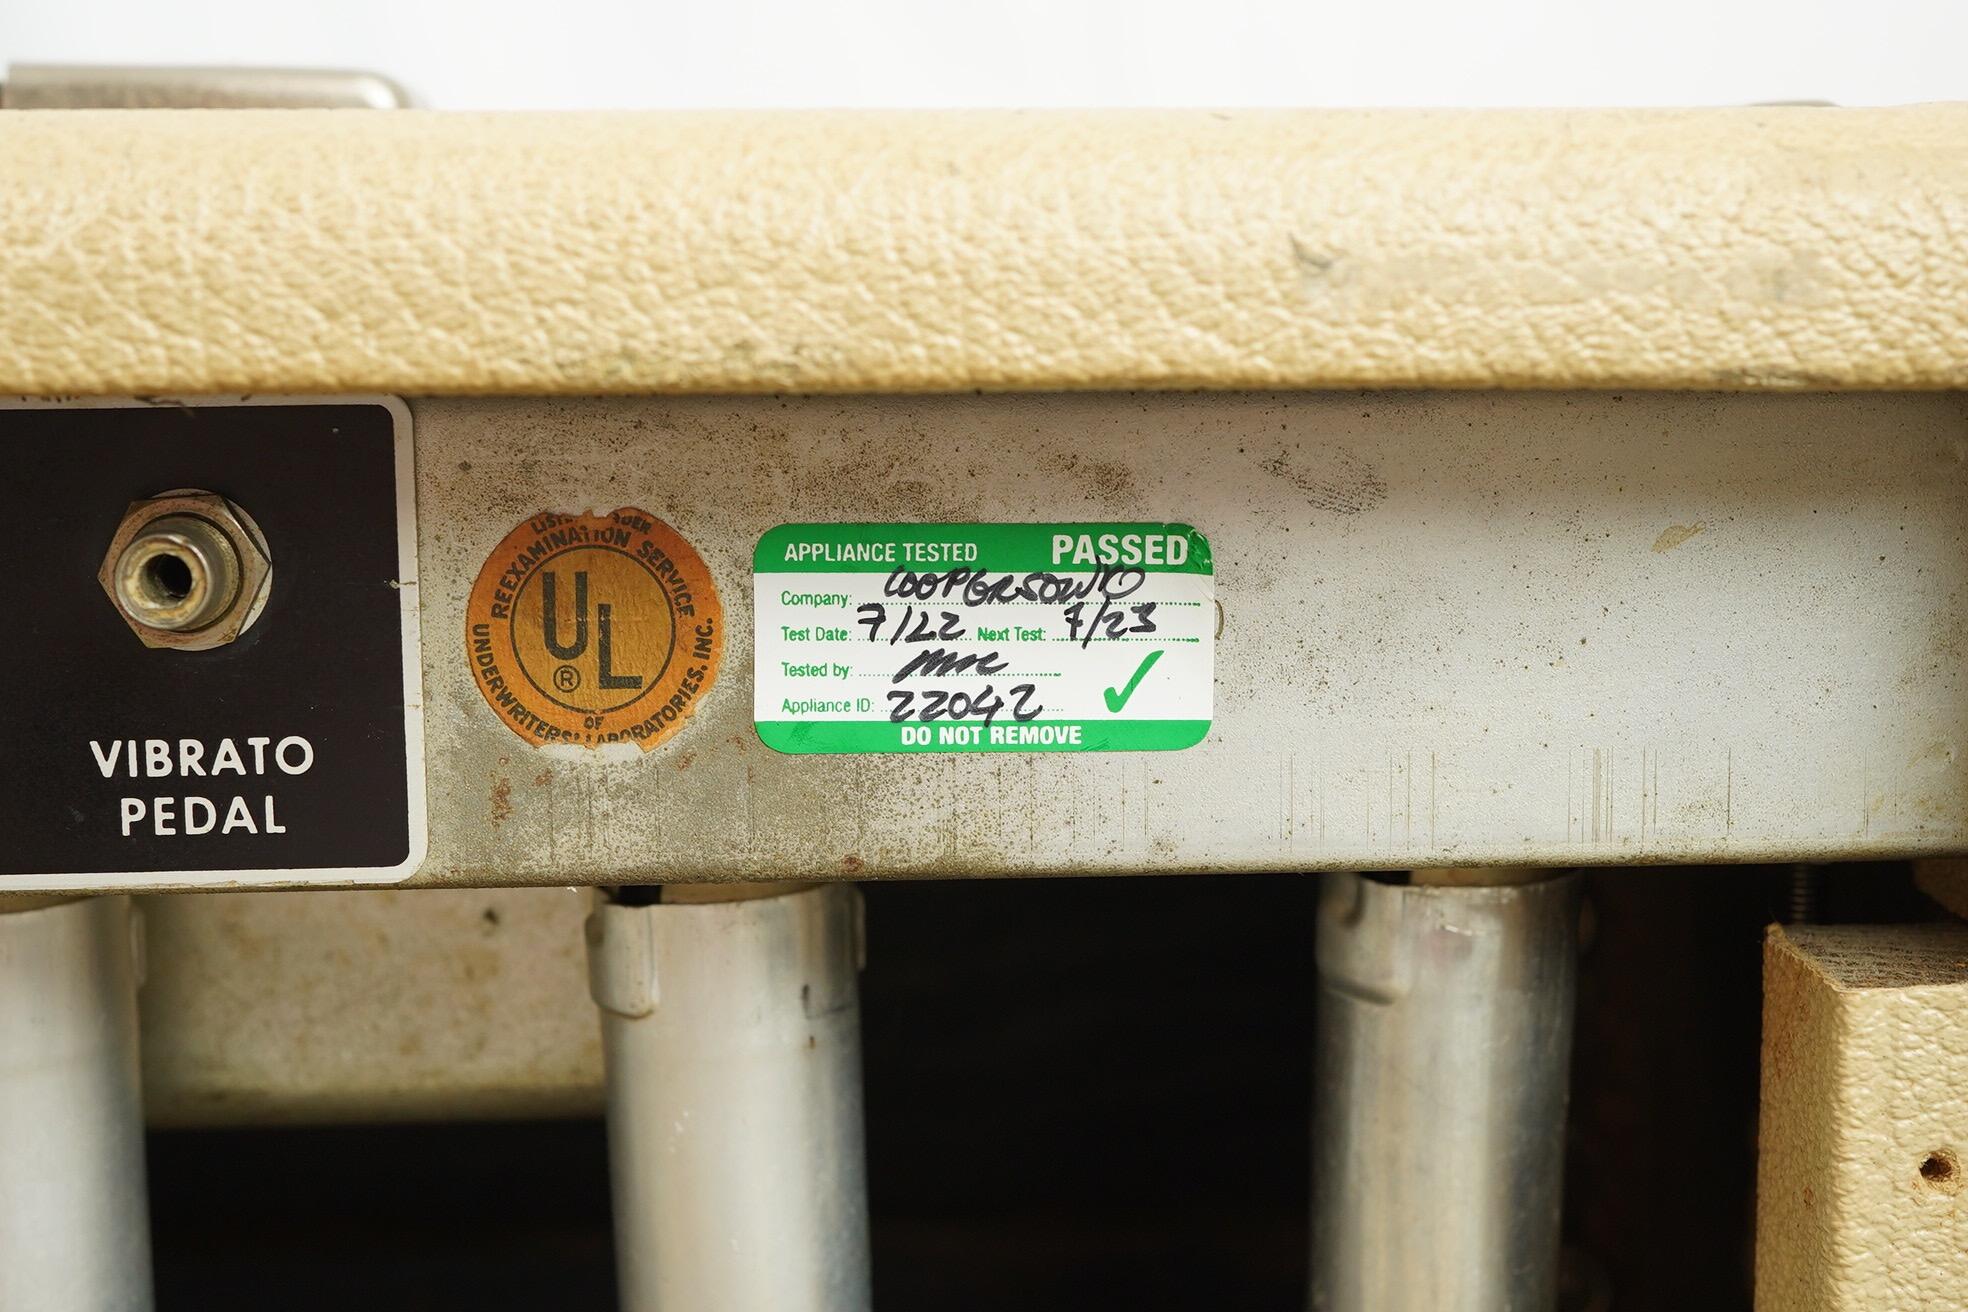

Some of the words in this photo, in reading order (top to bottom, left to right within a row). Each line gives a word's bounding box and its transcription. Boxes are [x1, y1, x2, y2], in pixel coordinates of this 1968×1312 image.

[784, 543, 896, 562] APPLIANCE
[902, 543, 978, 562] TESTED
[1052, 534, 1188, 565] PASSED
[491, 525, 632, 619] REEXAMINATION
[636, 540, 695, 618] SERVICE
[781, 590, 852, 608] Company:
[542, 571, 643, 690] UL
[781, 626, 810, 641] Test
[815, 627, 852, 641] Date:
[977, 627, 1010, 641] Next
[1013, 626, 1047, 642] Test:
[781, 662, 828, 677] Tested
[832, 661, 853, 680] by:
[781, 698, 851, 714] Appliance
[856, 698, 875, 712] ID:
[886, 684, 1043, 728] 22042
[583, 716, 604, 730] OF
[901, 726, 931, 745] DO
[939, 726, 983, 744] NOT
[990, 725, 1082, 745] REMOVE
[89, 736, 315, 778] VIBRATO
[121, 795, 287, 836] PEDAL
